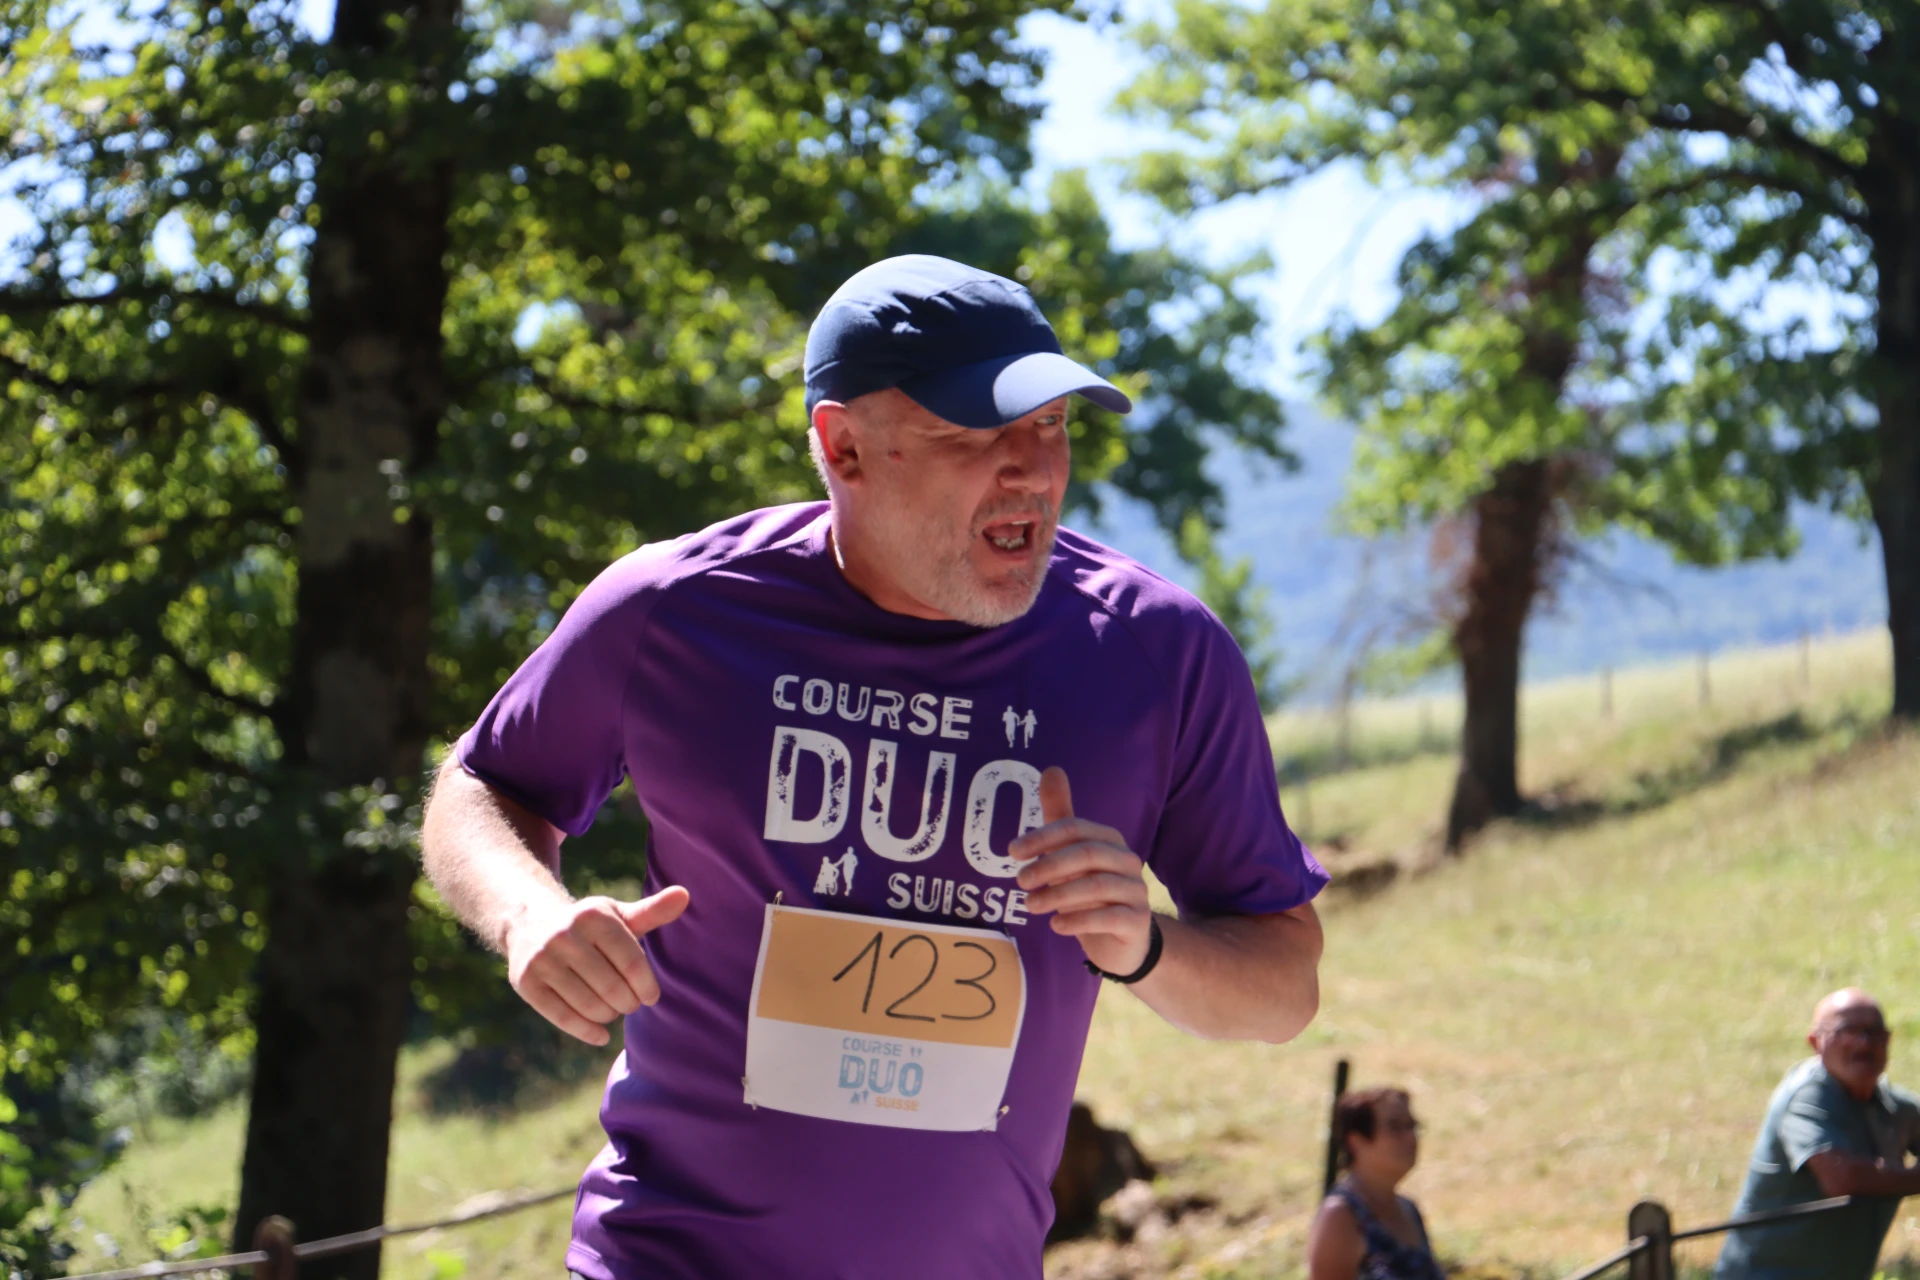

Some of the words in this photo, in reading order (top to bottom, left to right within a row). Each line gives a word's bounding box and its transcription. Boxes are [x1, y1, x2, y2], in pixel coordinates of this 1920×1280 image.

[772, 674, 974, 740] COURSE
[763, 725, 1045, 878] DUO
[886, 872, 1029, 925] SUISSE
[832, 931, 997, 1023] 123
[842, 1037, 903, 1057] COURSE
[838, 1054, 924, 1097] DUO
[875, 1096, 919, 1112] SUISSE
